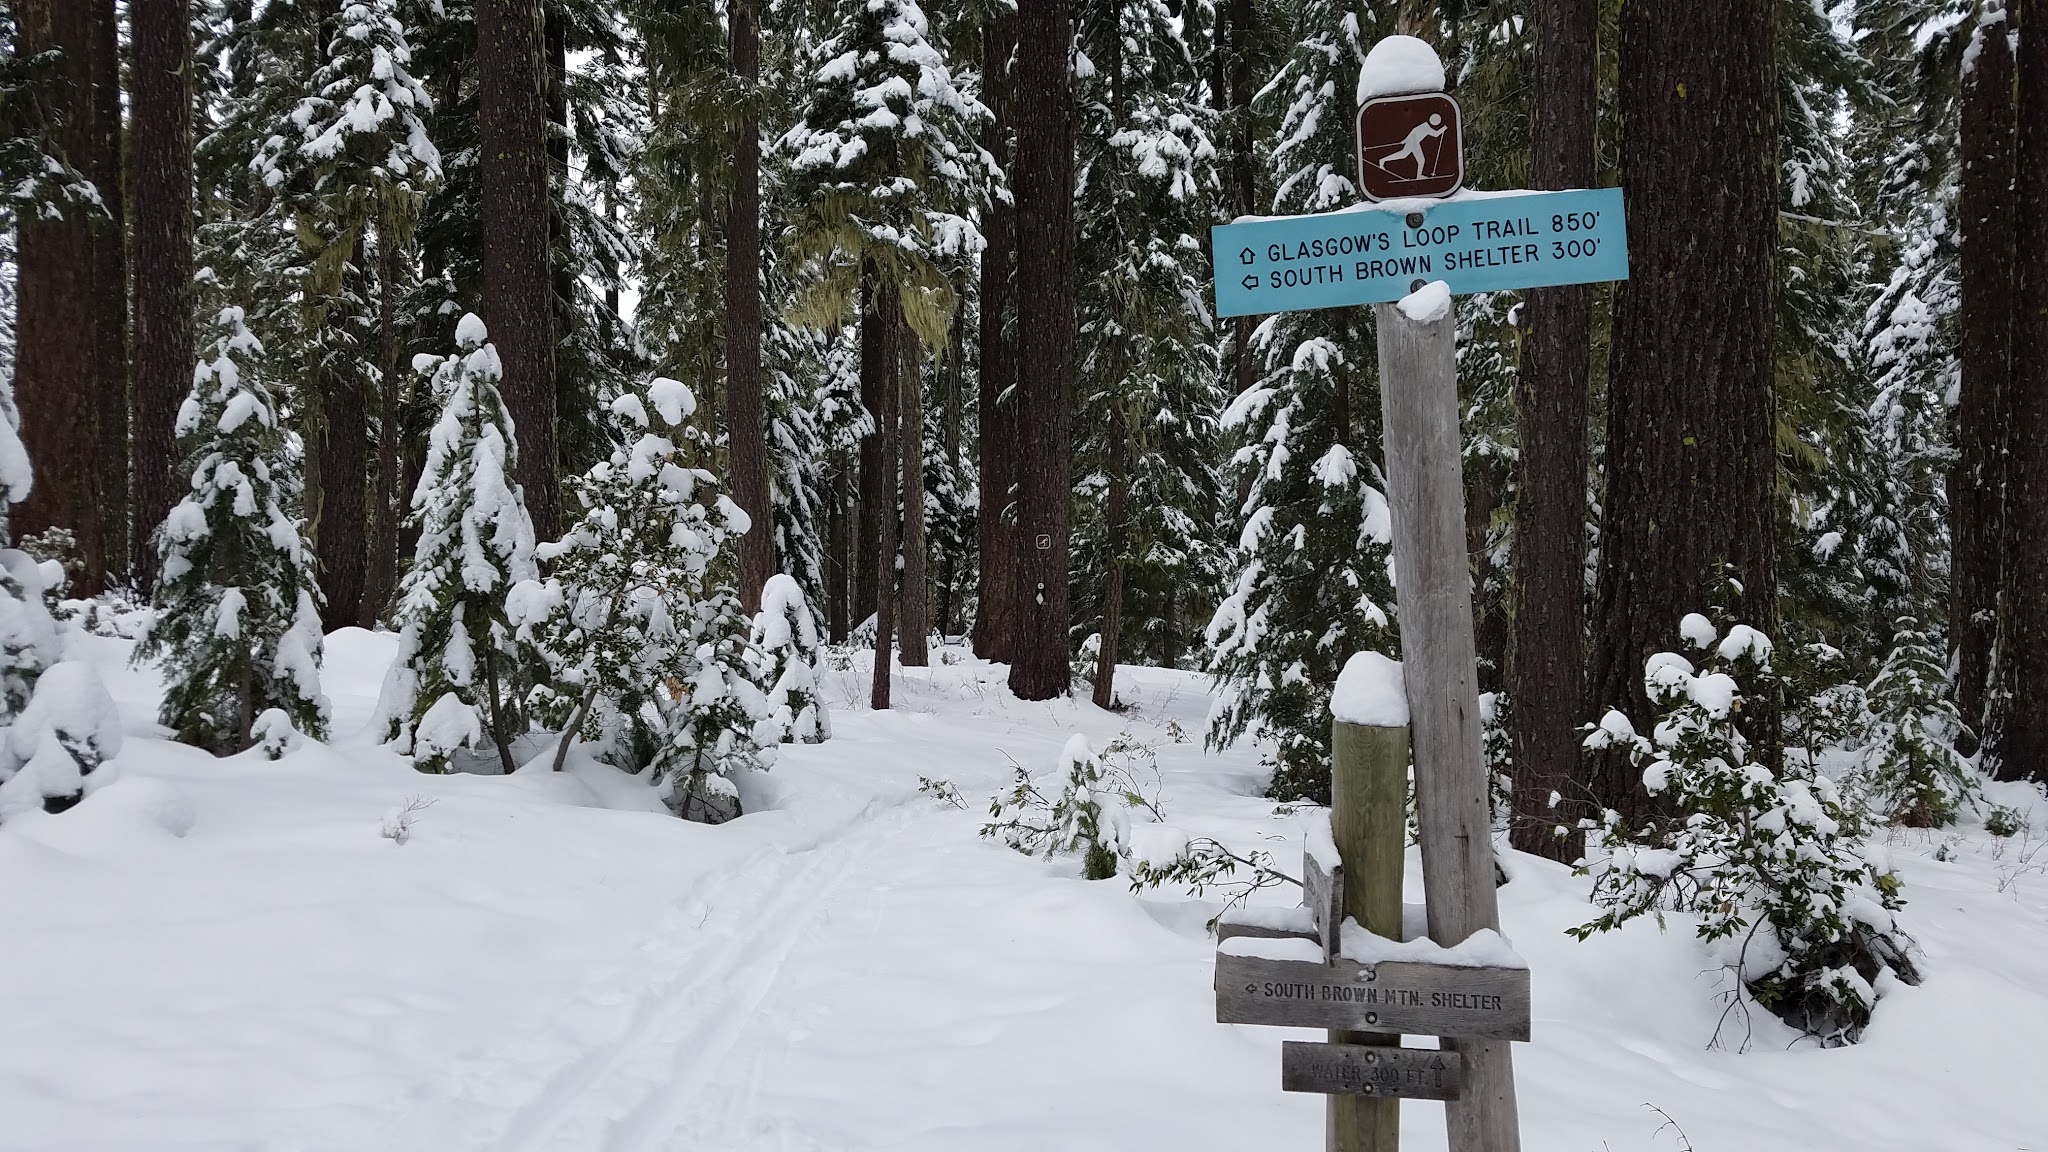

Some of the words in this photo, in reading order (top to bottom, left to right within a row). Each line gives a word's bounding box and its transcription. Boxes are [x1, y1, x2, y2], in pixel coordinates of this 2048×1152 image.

[1268, 233, 1390, 261] GLASGOW'S
[1404, 225, 1459, 247] LOOP
[1472, 217, 1539, 239] TRAIL
[1552, 211, 1602, 233] 850'
[1270, 264, 1342, 288] SOUTH
[1356, 255, 1431, 280] BROWN
[1445, 244, 1539, 271] SHELTER
[1552, 238, 1602, 259] 300'
[1264, 983, 1315, 1000] SOUTH
[1321, 986, 1378, 1003] BROWN
[1385, 990, 1424, 1007] MTN.
[1431, 992, 1502, 1010] SHELTER
[1311, 1063, 1361, 1081] WATER
[1369, 1067, 1399, 1083] 300
[1406, 1069, 1428, 1085] FT.
